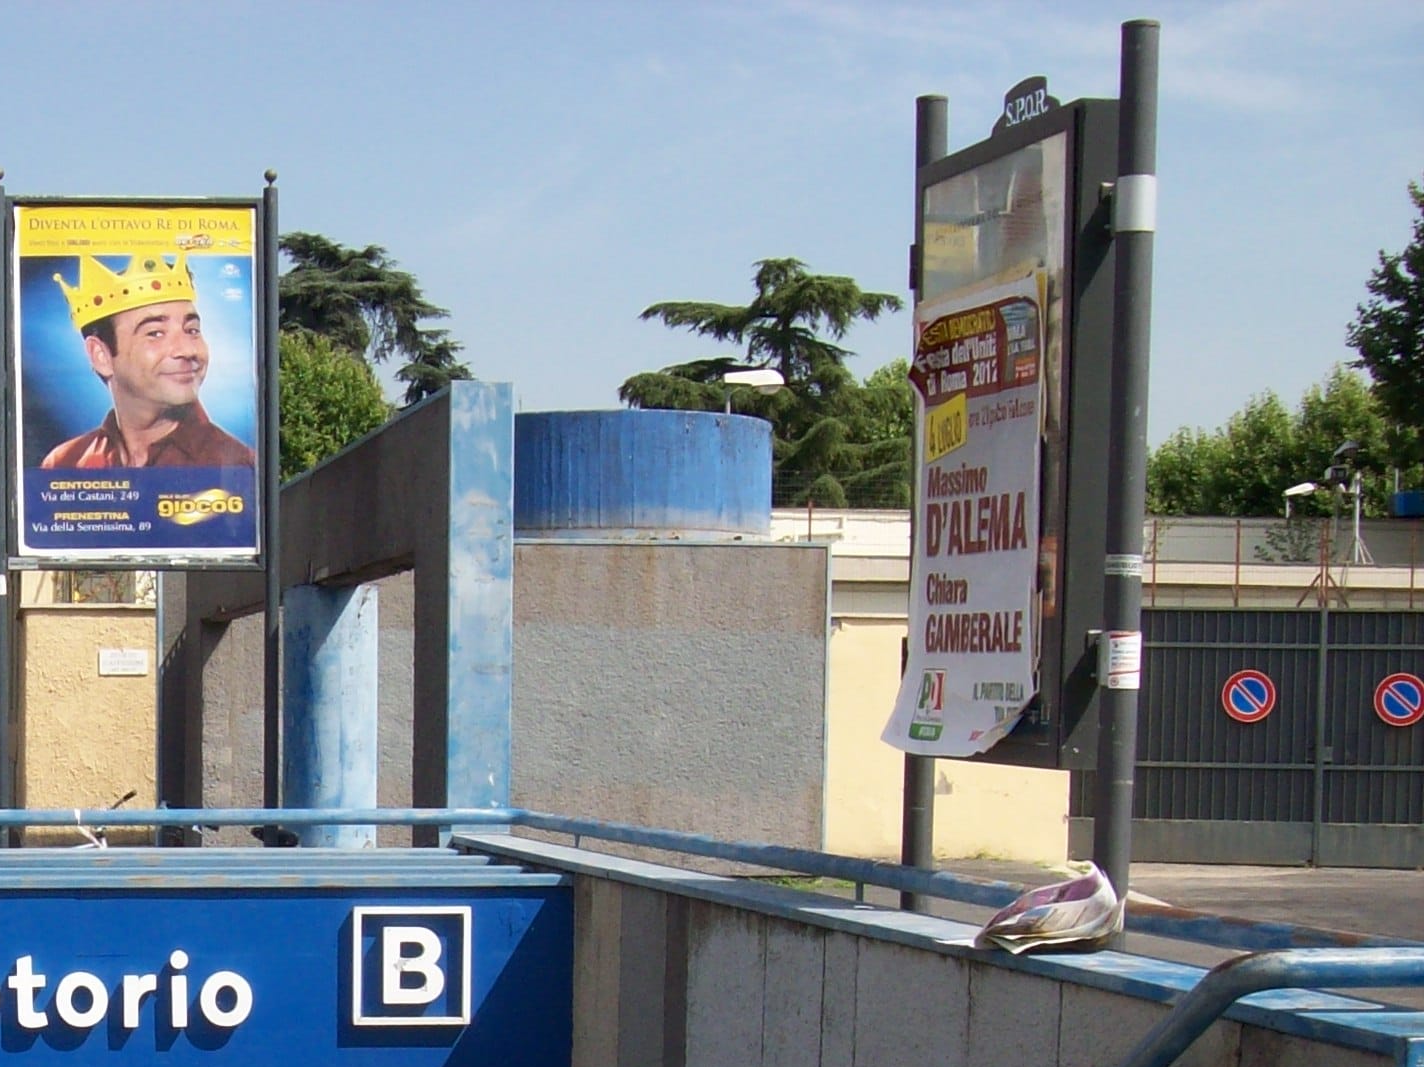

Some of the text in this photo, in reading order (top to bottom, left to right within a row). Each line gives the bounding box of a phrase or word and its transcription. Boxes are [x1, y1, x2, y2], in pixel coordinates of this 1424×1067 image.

[29, 218, 86, 231] DIVENTA
[91, 216, 152, 230] L'OTTAVO
[157, 217, 173, 230] RE
[178, 217, 193, 229] DI
[972, 359, 998, 387] 2012
[50, 480, 130, 490] CENTOCELLE
[927, 463, 987, 499] Massimo
[41, 491, 60, 502] Via
[61, 491, 76, 502] dei
[120, 491, 140, 501] 249
[32, 521, 152, 534] Via della Serenissima, 89
[54, 511, 130, 521] PRENESTINA
[926, 491, 1027, 558] D'ALEMA
[926, 573, 968, 606] Chiara
[925, 611, 1023, 654] GAMBERALE
[382, 926, 445, 1005] B
